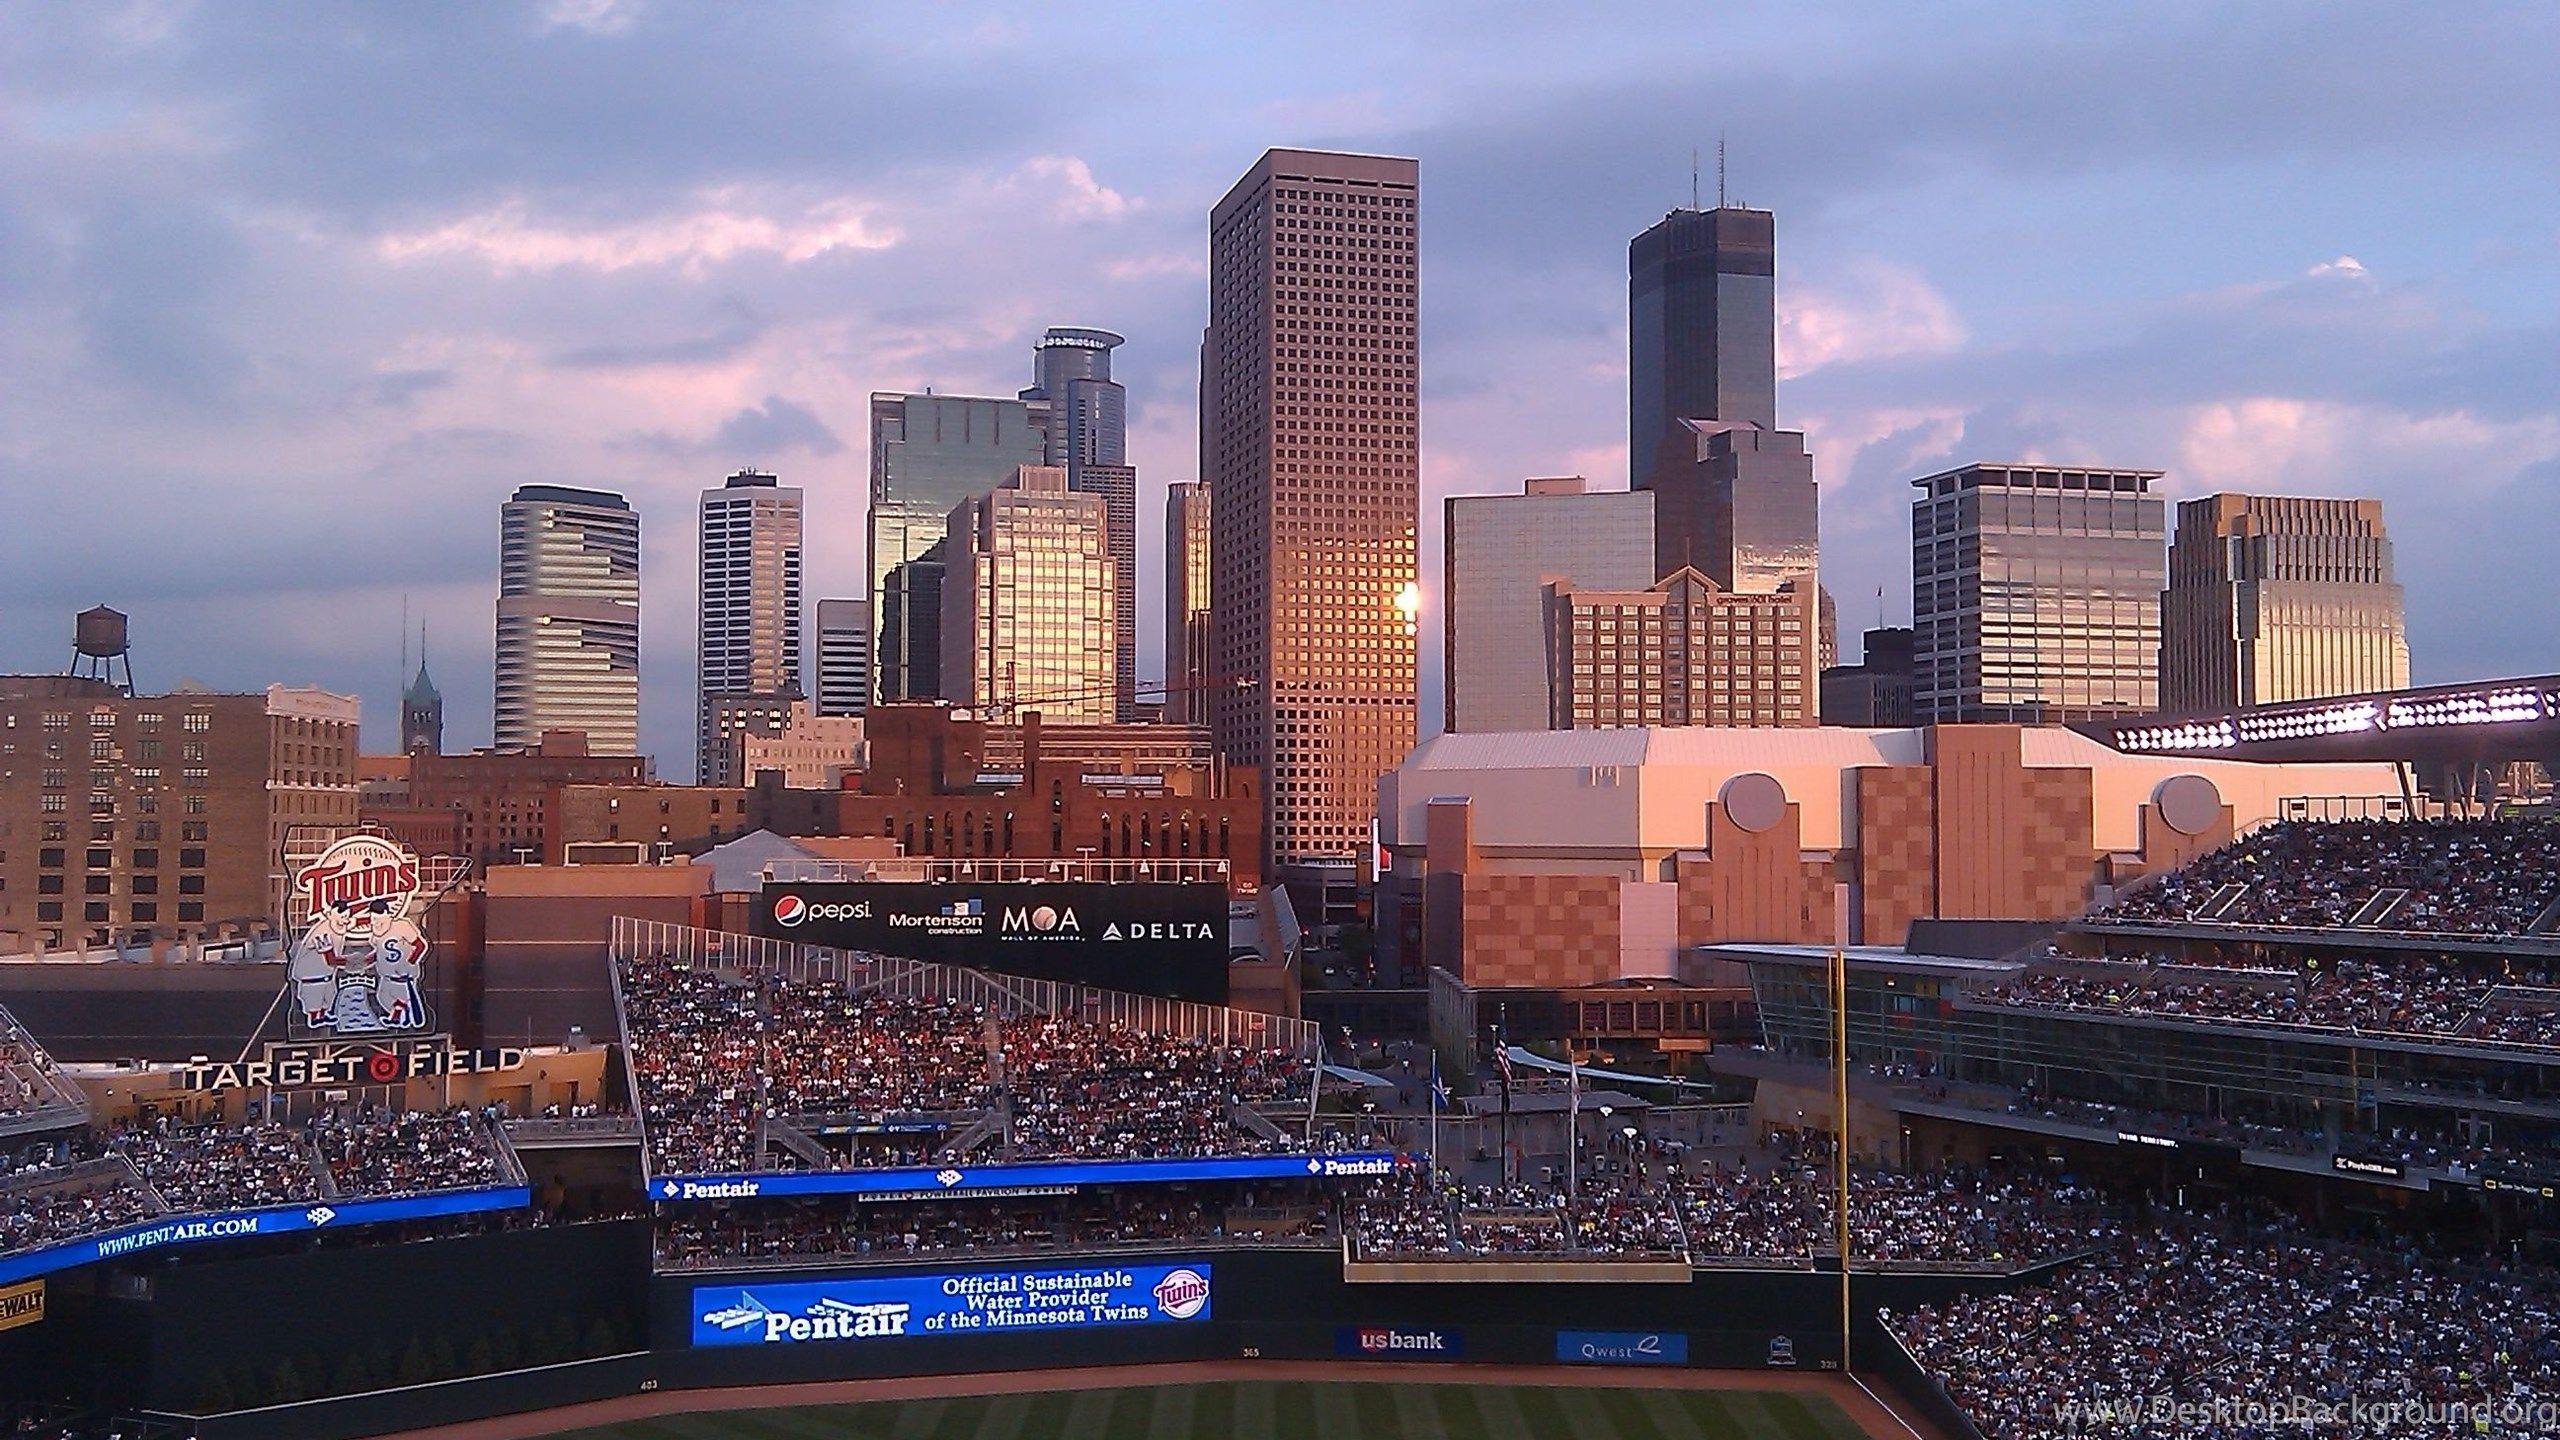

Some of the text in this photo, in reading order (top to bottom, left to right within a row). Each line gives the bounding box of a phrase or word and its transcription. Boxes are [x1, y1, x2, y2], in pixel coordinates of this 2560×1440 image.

[298, 857, 417, 916] Twins
[808, 901, 872, 922] pepsi
[889, 914, 983, 927] Mortenson
[1131, 923, 1214, 939] DELTA
[185, 1048, 526, 1090] TARGET FIELD
[1324, 1159, 1392, 1176] Pentair
[683, 1180, 760, 1199] Pentair
[98, 1218, 258, 1257] WWW.PENTAIR.COM
[942, 1270, 1133, 1295] Official Sustainable
[1155, 1278, 1208, 1310] Twins
[966, 1289, 1109, 1311] Water Provider
[764, 1311, 909, 1342] Pentair
[925, 1304, 1149, 1330] of the Minnesota Twins
[1581, 1343, 1633, 1359] Qwest
